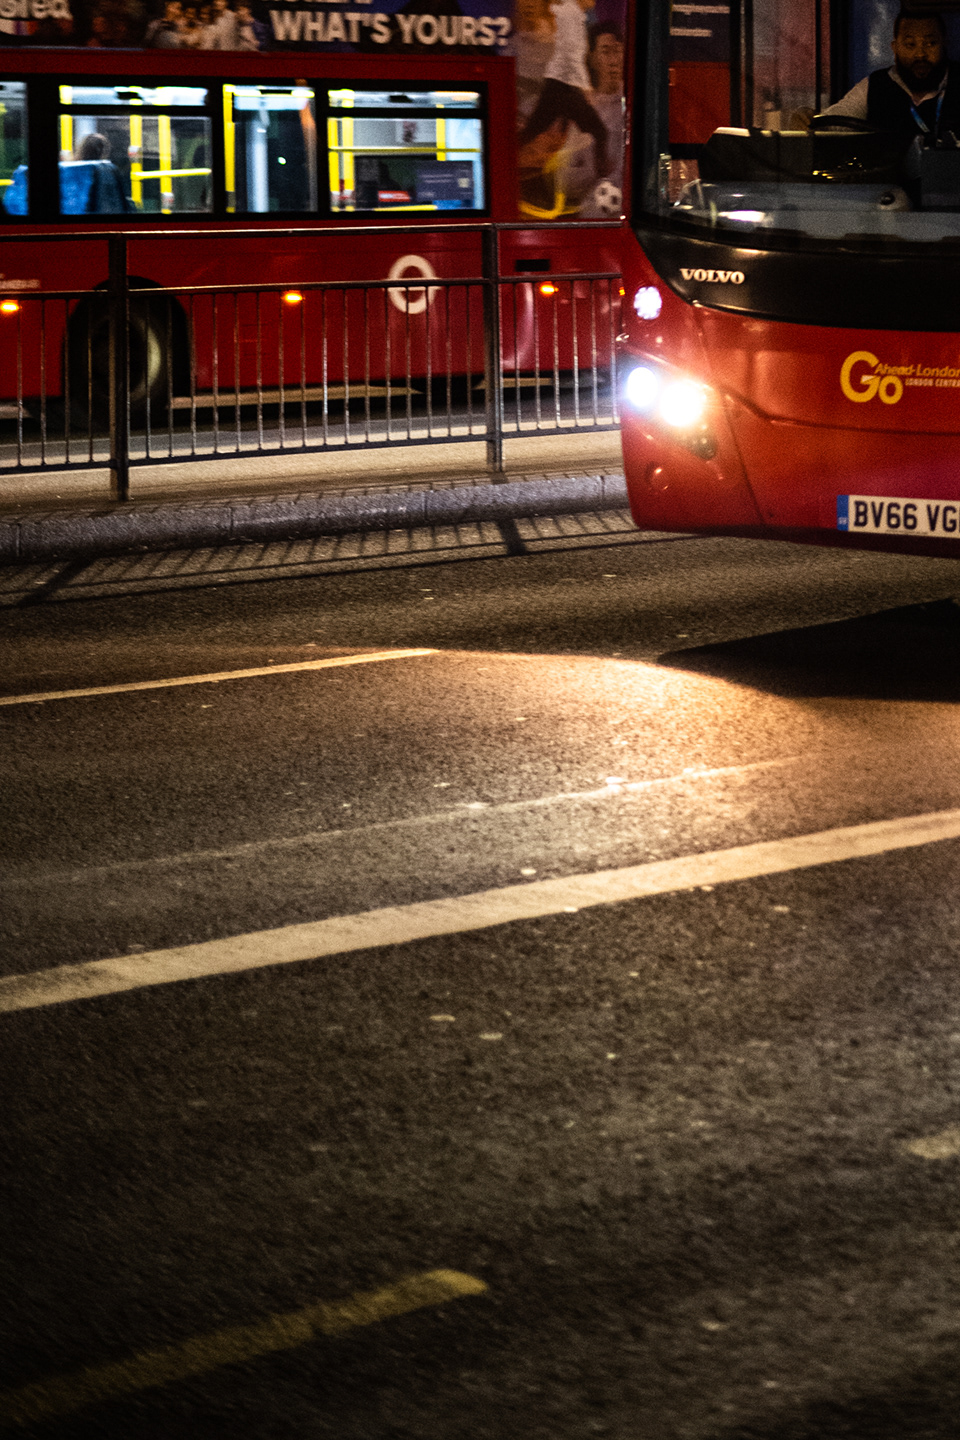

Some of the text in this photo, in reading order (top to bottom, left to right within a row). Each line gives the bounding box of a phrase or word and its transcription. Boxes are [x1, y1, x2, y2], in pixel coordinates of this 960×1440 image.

[270, 10, 512, 46] WHAT'S YOURS?
[679, 268, 745, 285] VOLVO
[840, 350, 903, 404] Go
[905, 378, 934, 386] LONDON
[853, 500, 918, 530] BV66
